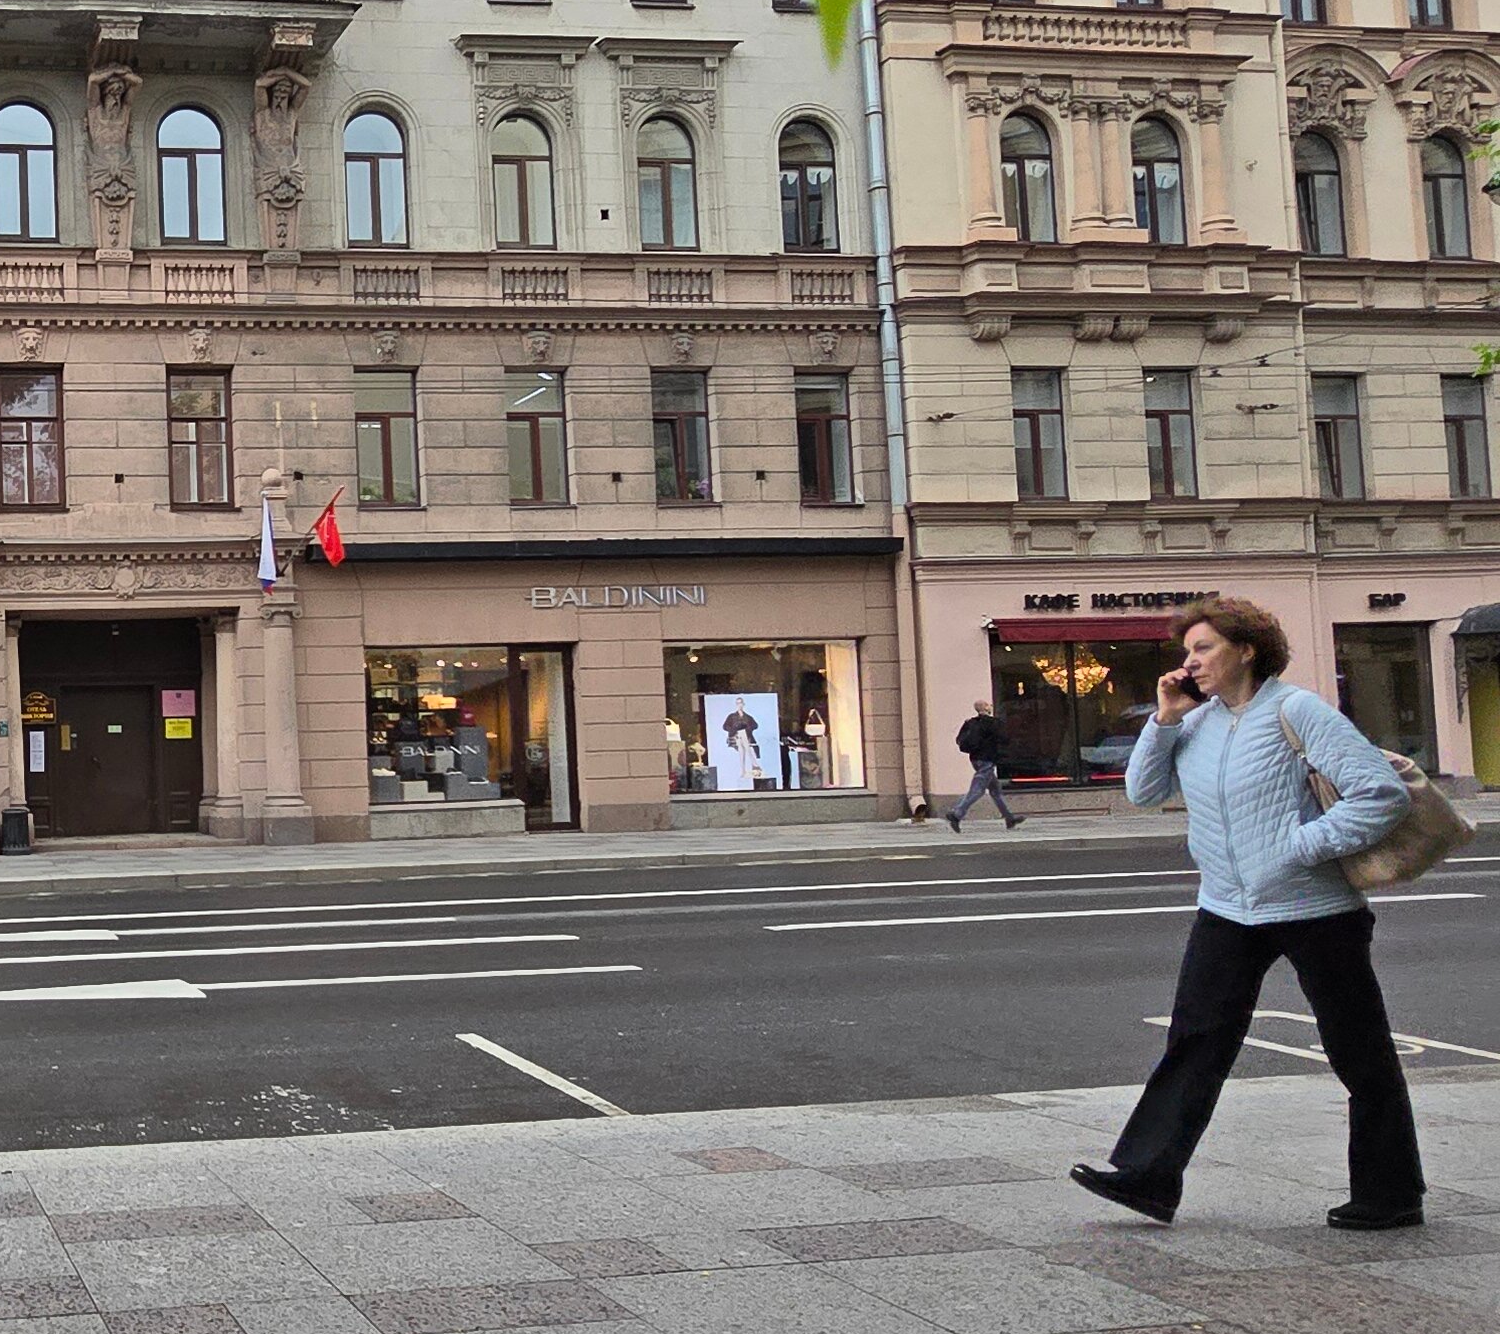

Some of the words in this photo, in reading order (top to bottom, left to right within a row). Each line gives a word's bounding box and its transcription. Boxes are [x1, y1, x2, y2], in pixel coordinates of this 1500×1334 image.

[524, 585, 706, 608] BALDININI
[1023, 593, 1080, 610] КАФЕ
[1368, 593, 1406, 608] БАР
